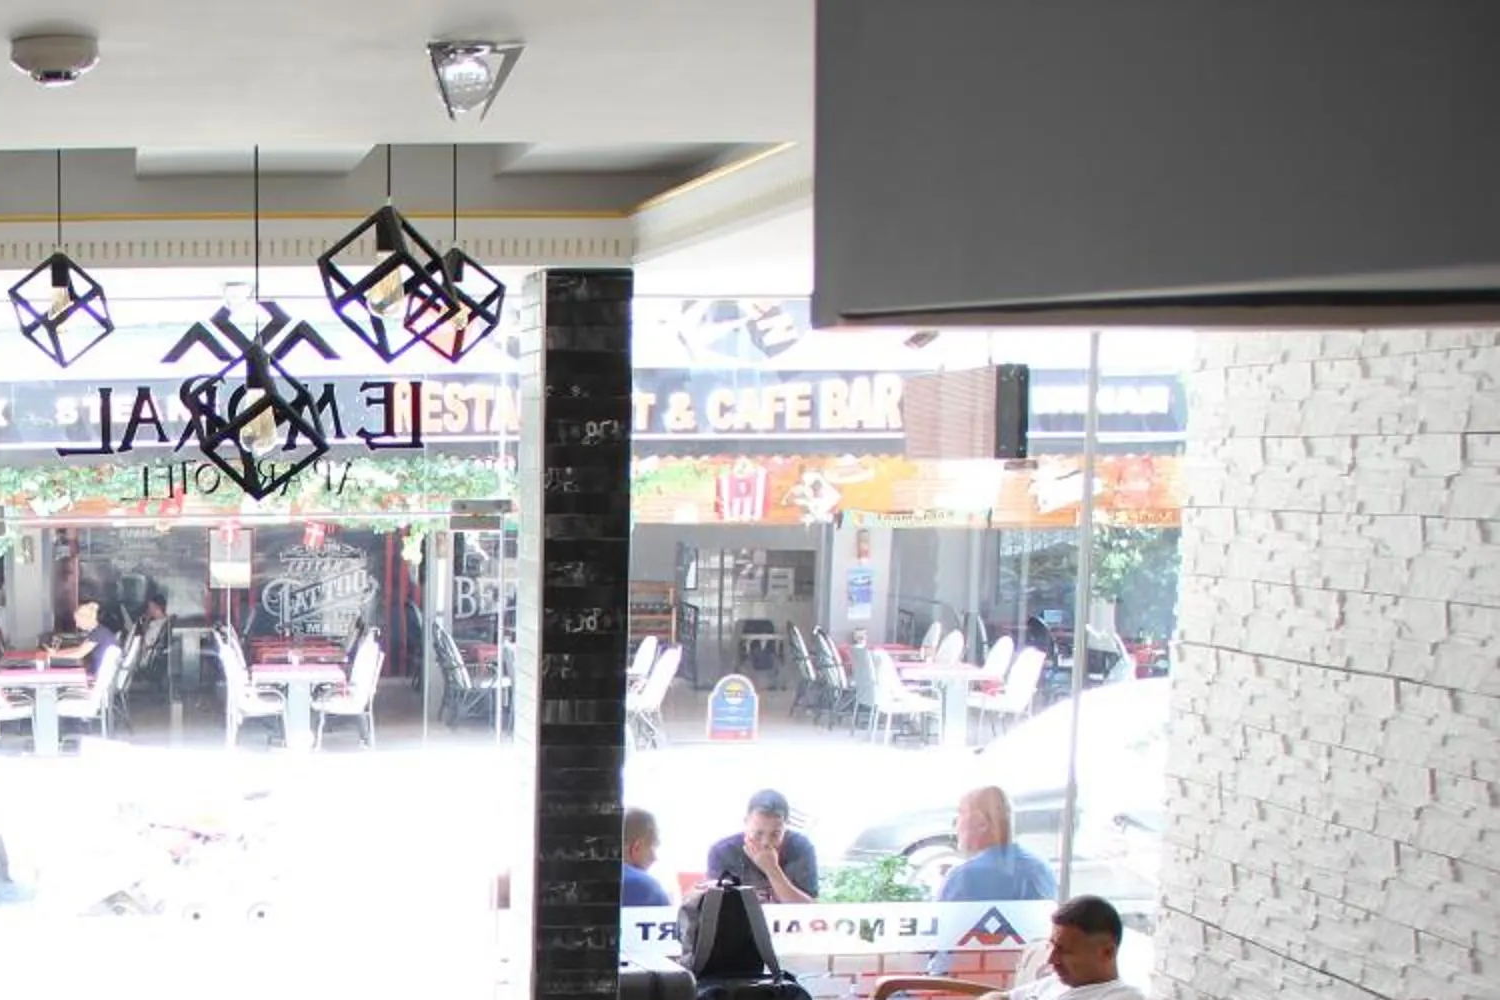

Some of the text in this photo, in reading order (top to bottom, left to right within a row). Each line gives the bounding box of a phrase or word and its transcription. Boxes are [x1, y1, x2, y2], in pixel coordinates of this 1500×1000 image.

[664, 392, 696, 431] &
[706, 381, 813, 431] CAFE
[819, 373, 903, 430] BAR
[453, 576, 519, 619] BEE
